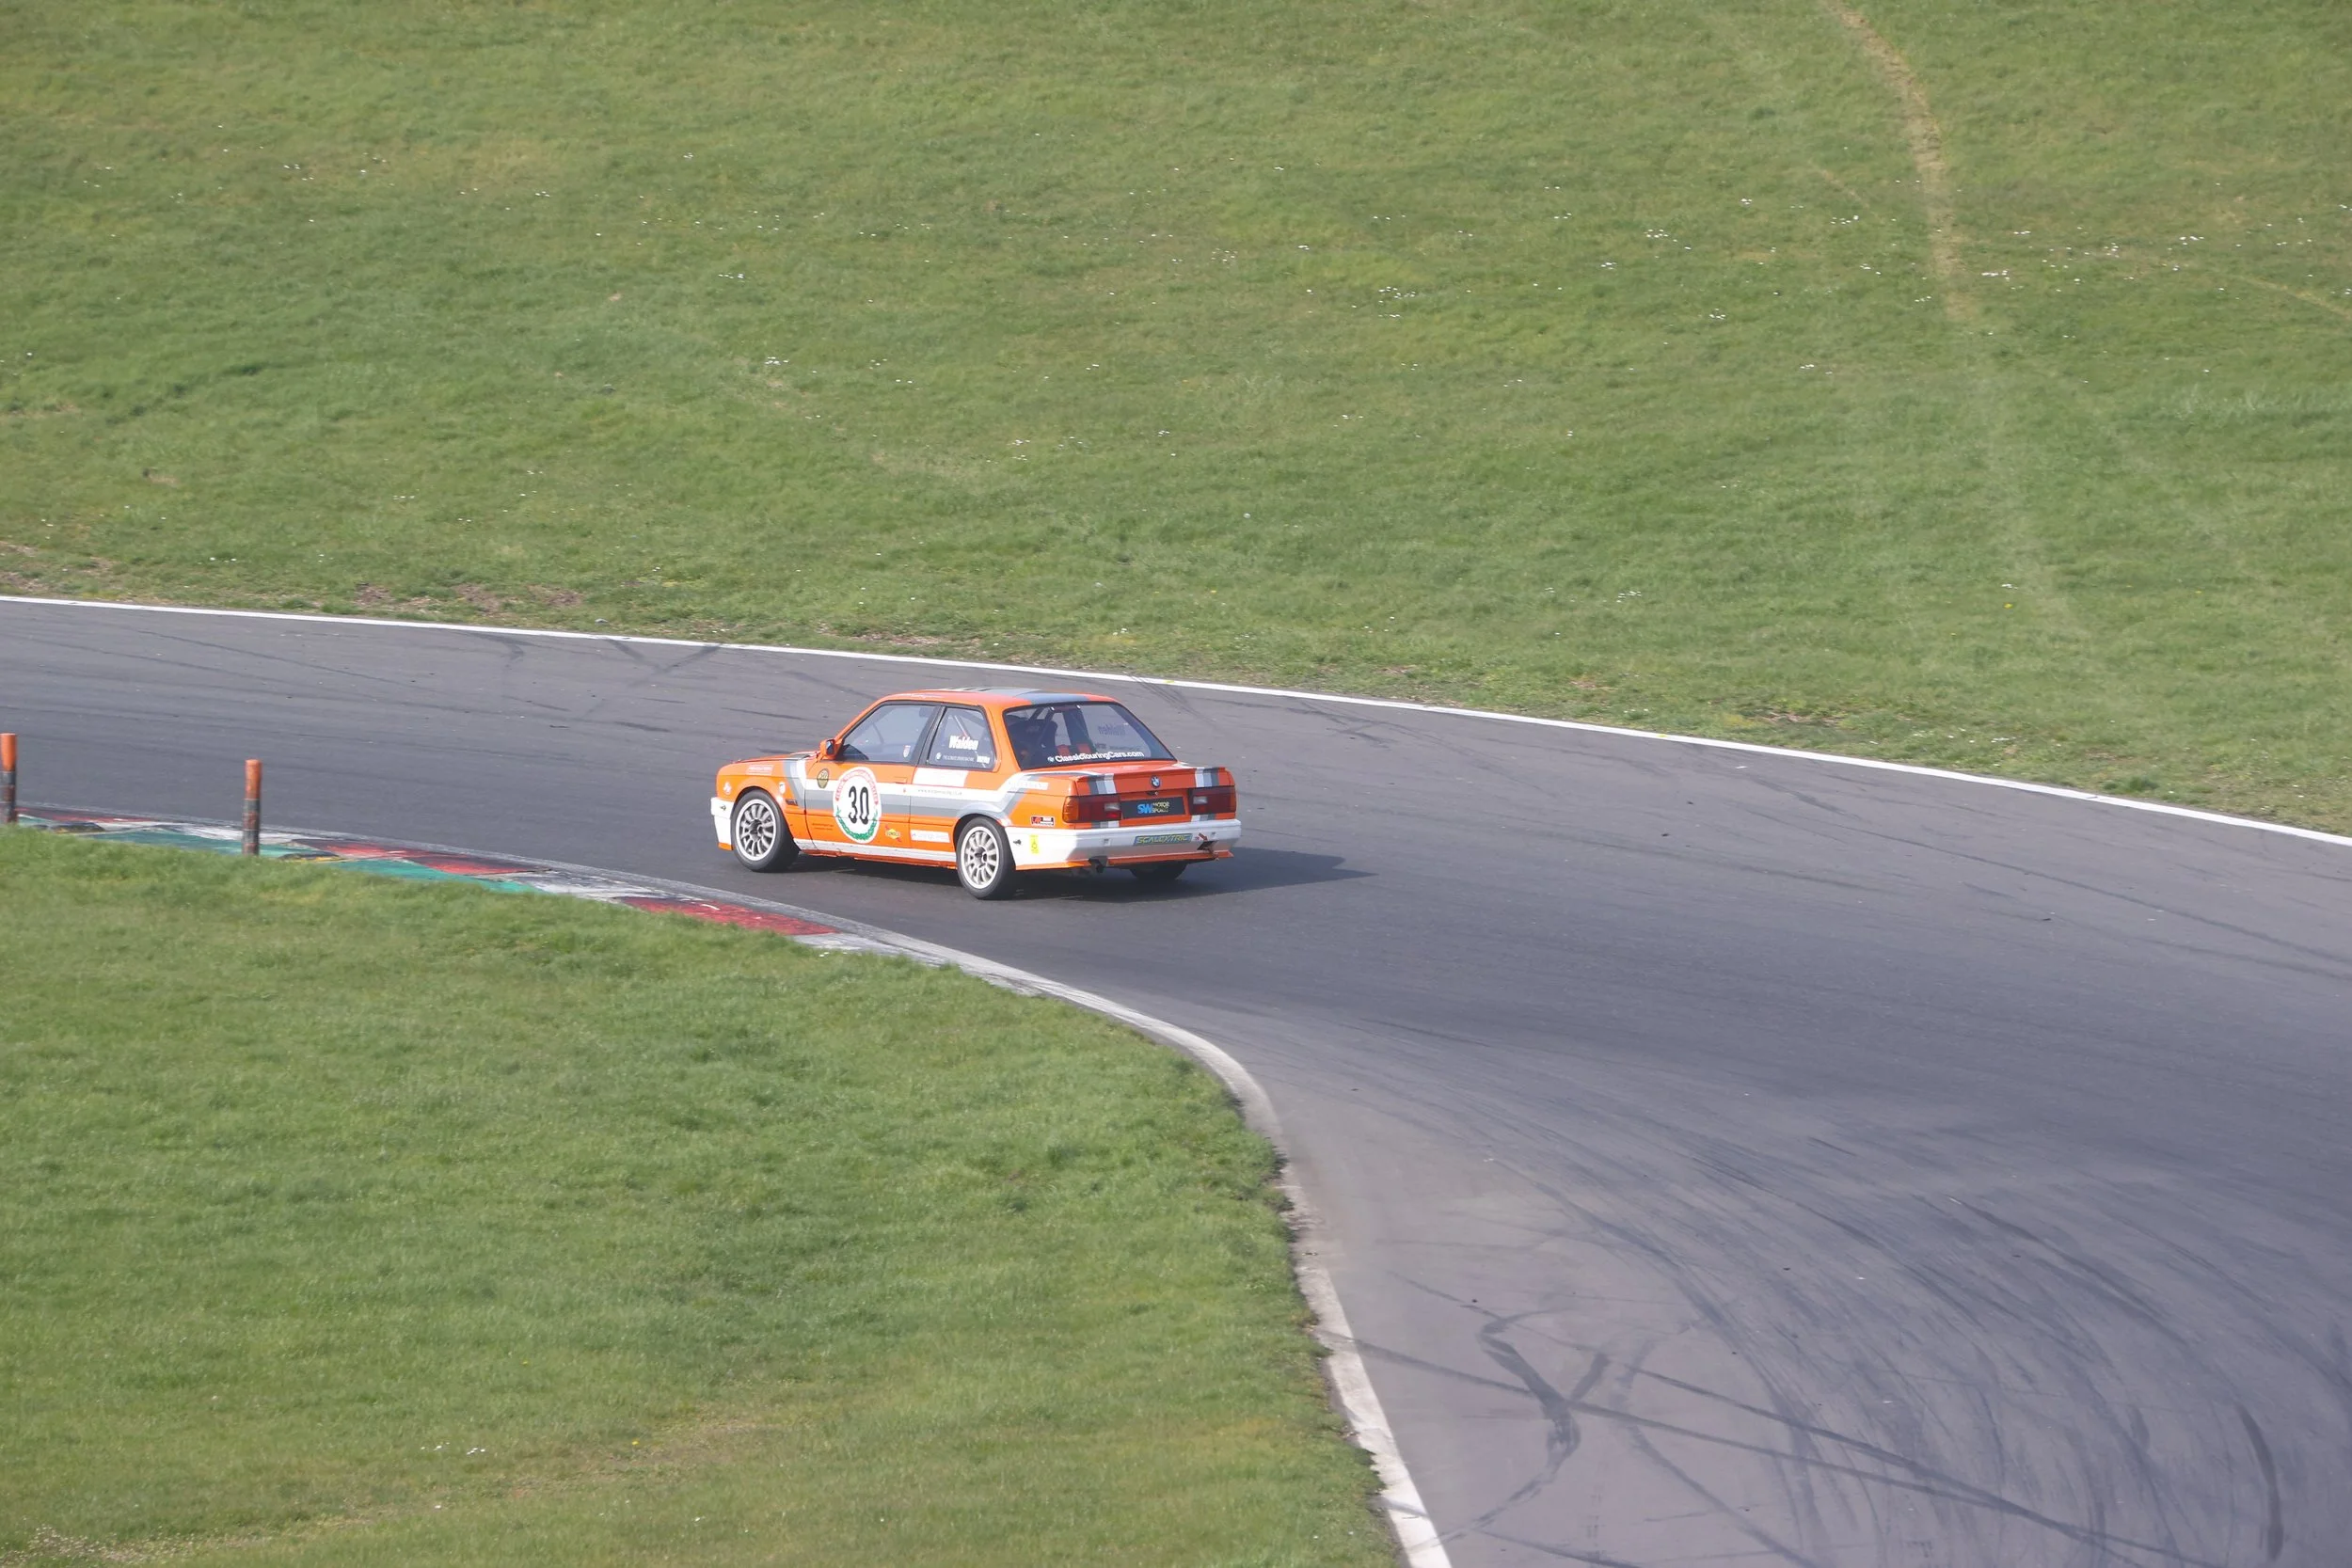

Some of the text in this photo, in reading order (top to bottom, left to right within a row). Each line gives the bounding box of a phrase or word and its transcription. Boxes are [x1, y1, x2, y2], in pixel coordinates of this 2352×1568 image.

[949, 735, 978, 751] Walden
[1055, 751, 1145, 763] ClassicTouringCars.com
[848, 785, 870, 825] 30
[1136, 803, 1152, 815] SW
